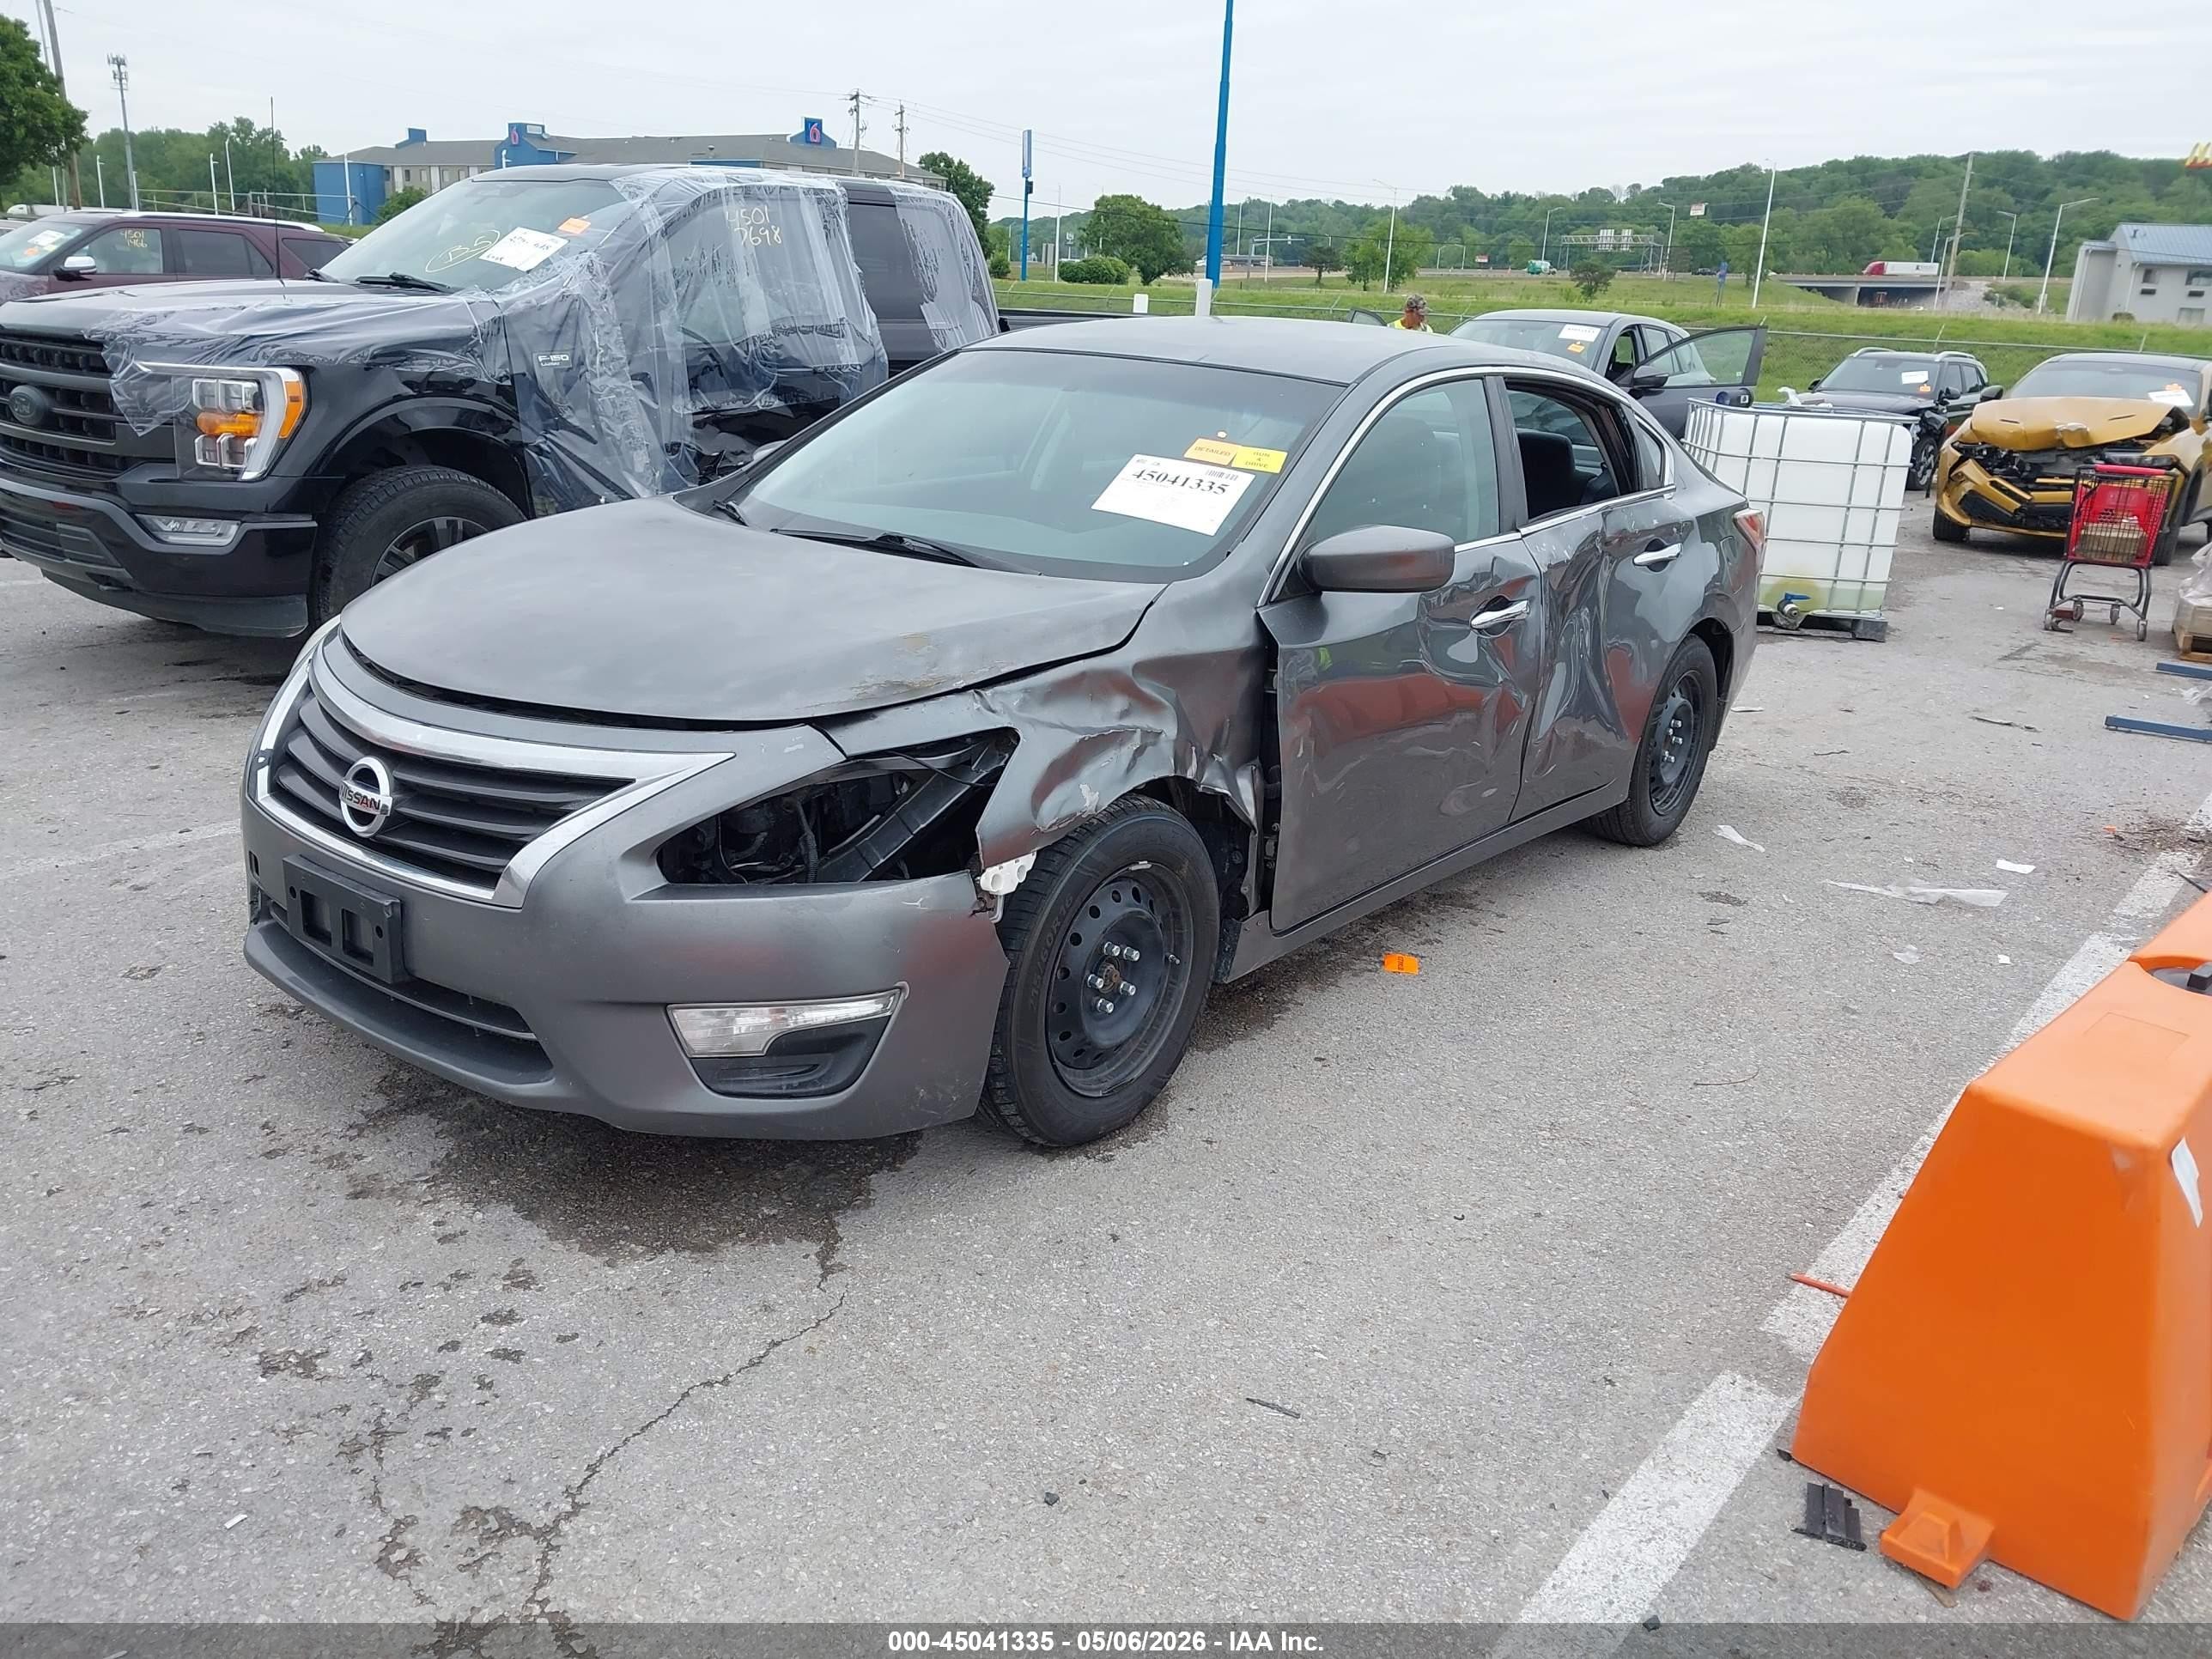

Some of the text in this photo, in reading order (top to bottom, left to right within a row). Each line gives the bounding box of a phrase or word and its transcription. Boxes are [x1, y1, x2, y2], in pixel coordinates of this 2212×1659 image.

[809, 122, 821, 143] 6
[726, 205, 770, 227] 4501
[734, 225, 782, 246] 7698
[1194, 446, 1232, 457] DETAILED
[1132, 469, 1231, 495] 45041335
[339, 782, 381, 811] NISSAN
